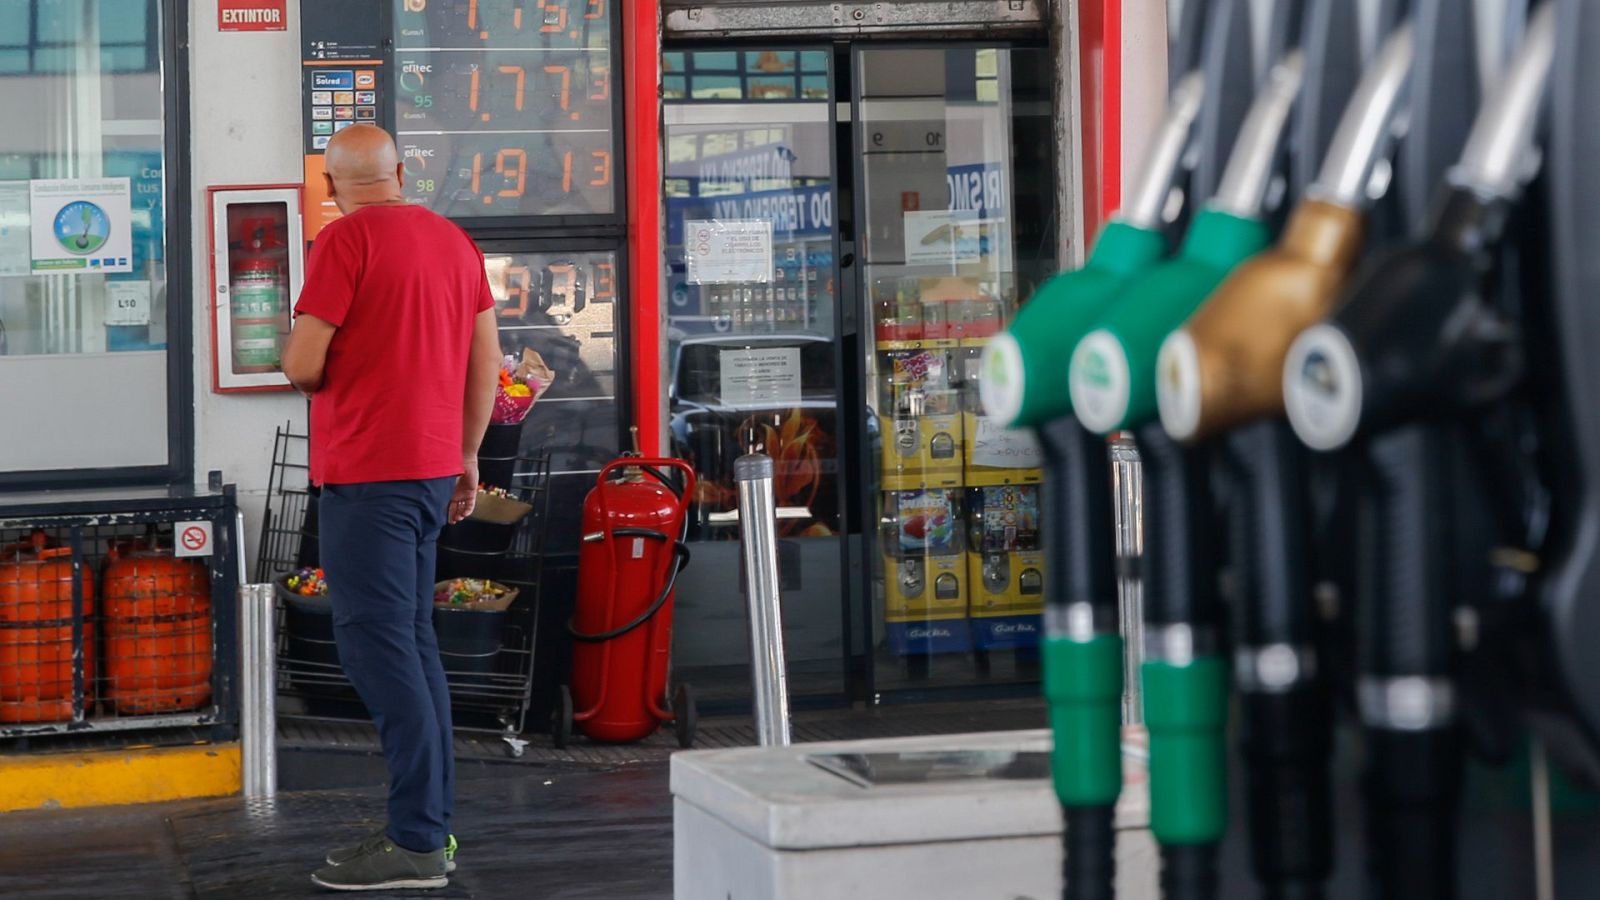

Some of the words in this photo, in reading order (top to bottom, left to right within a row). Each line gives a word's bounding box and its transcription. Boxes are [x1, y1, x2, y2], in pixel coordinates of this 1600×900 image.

[222, 9, 281, 23] EXTINTOR
[316, 77, 340, 85] Solred
[414, 95, 433, 108] 95
[137, 182, 158, 193] tus
[416, 179, 435, 192] 98
